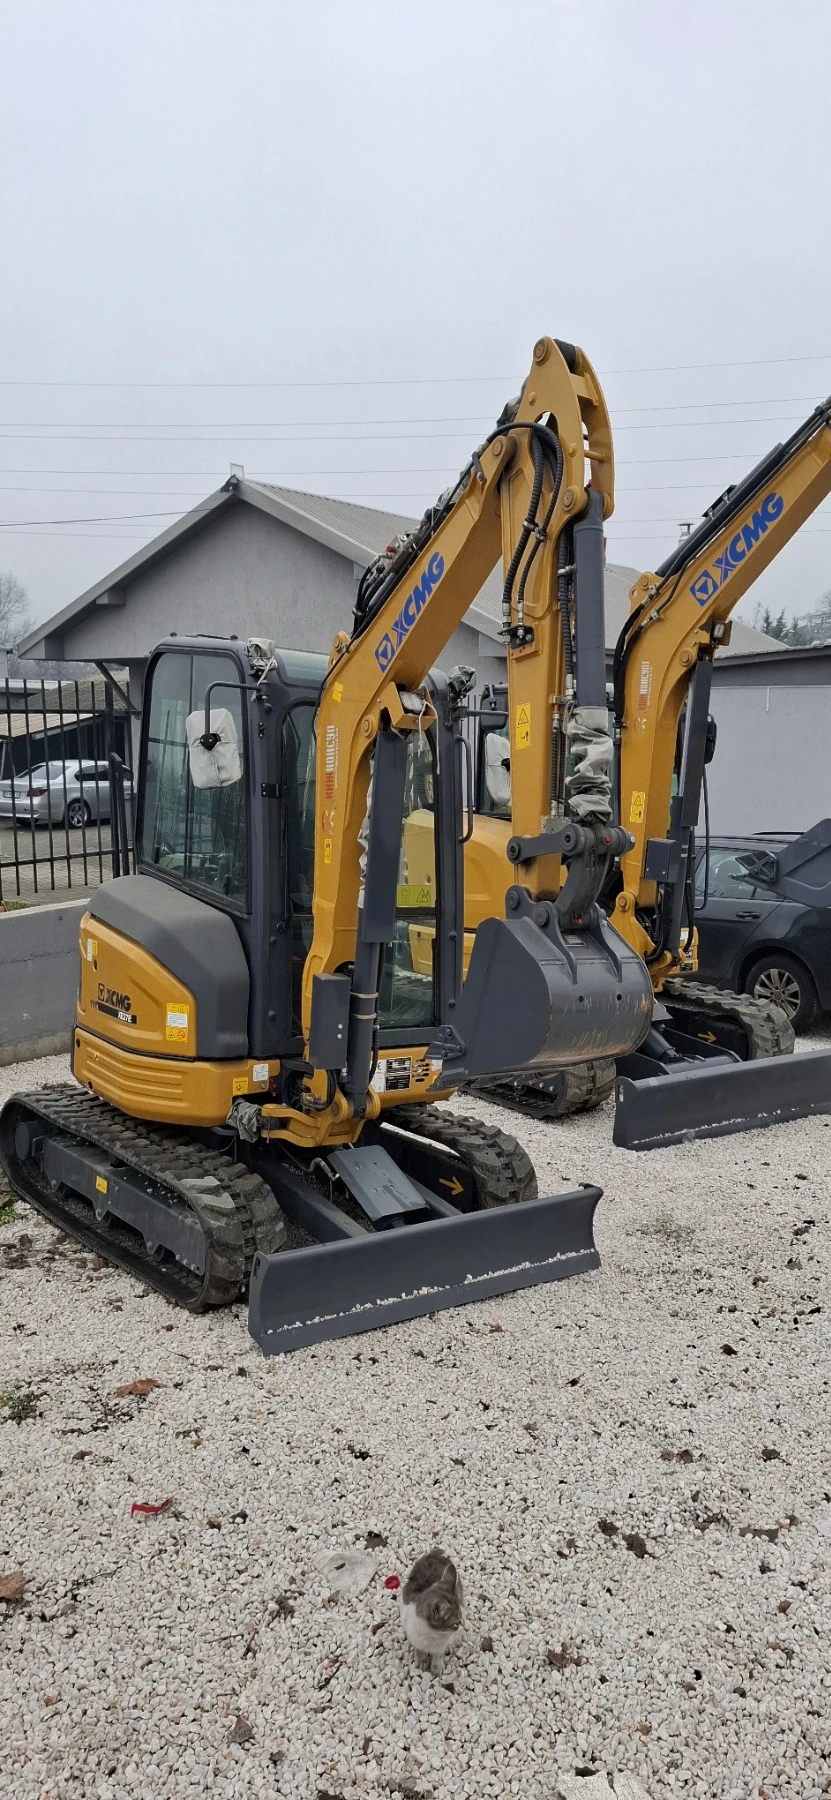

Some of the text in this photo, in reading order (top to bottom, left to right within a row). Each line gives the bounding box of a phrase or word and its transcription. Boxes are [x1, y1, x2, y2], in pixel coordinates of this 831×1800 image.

[712, 492, 784, 587] XCMG
[391, 551, 445, 651] XCMG
[106, 988, 131, 1012] XCMG
